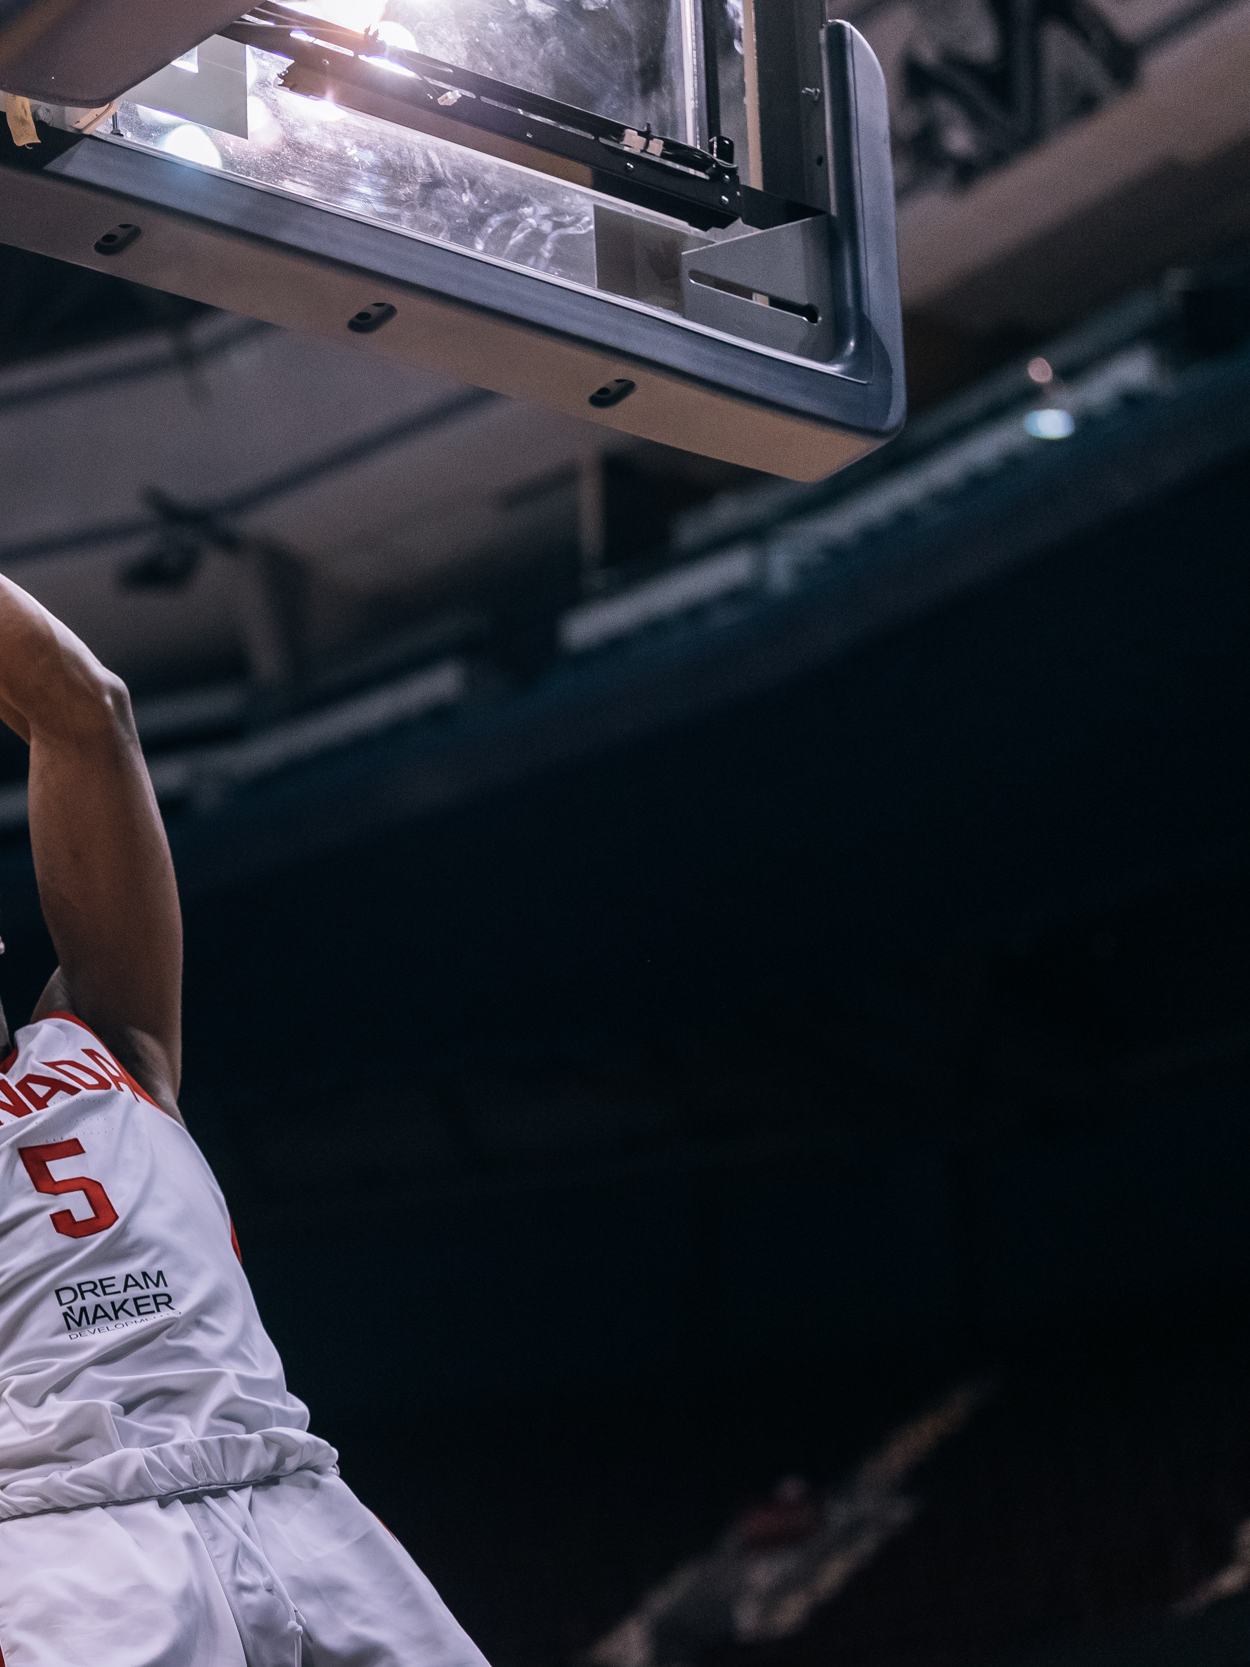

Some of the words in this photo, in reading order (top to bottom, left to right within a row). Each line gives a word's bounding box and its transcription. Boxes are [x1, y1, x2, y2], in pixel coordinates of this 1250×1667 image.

[17, 1137, 120, 1239] 5
[54, 1269, 168, 1307] DREAM
[62, 1292, 176, 1331] MAKER
[68, 1311, 182, 1340] DEVELOPMS
